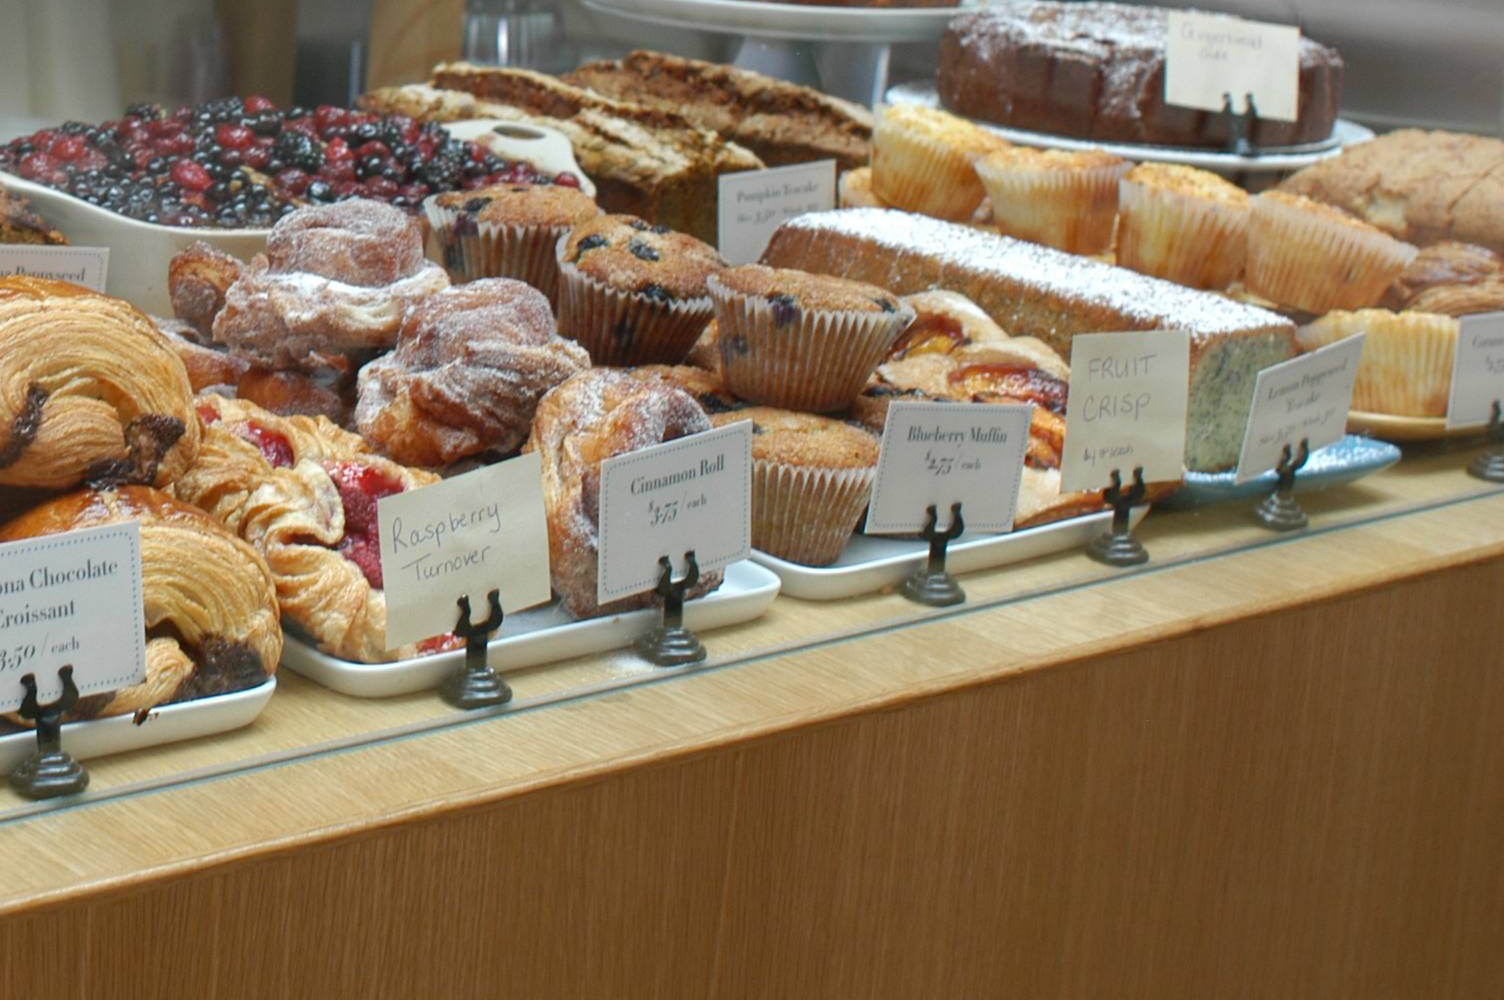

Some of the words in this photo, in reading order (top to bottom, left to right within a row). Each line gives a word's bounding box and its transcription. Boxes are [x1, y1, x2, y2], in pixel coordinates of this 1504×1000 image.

[1088, 354, 1157, 384] FRUIT
[1083, 392, 1152, 423] CRISP
[907, 425, 964, 448] Blueberry
[970, 426, 1008, 443] Muffin
[630, 468, 696, 496] Cinnamon
[699, 454, 725, 477] Roll
[392, 503, 501, 554] Raspberry
[29, 559, 119, 589] Chocolate
[402, 546, 491, 581] Turnover
